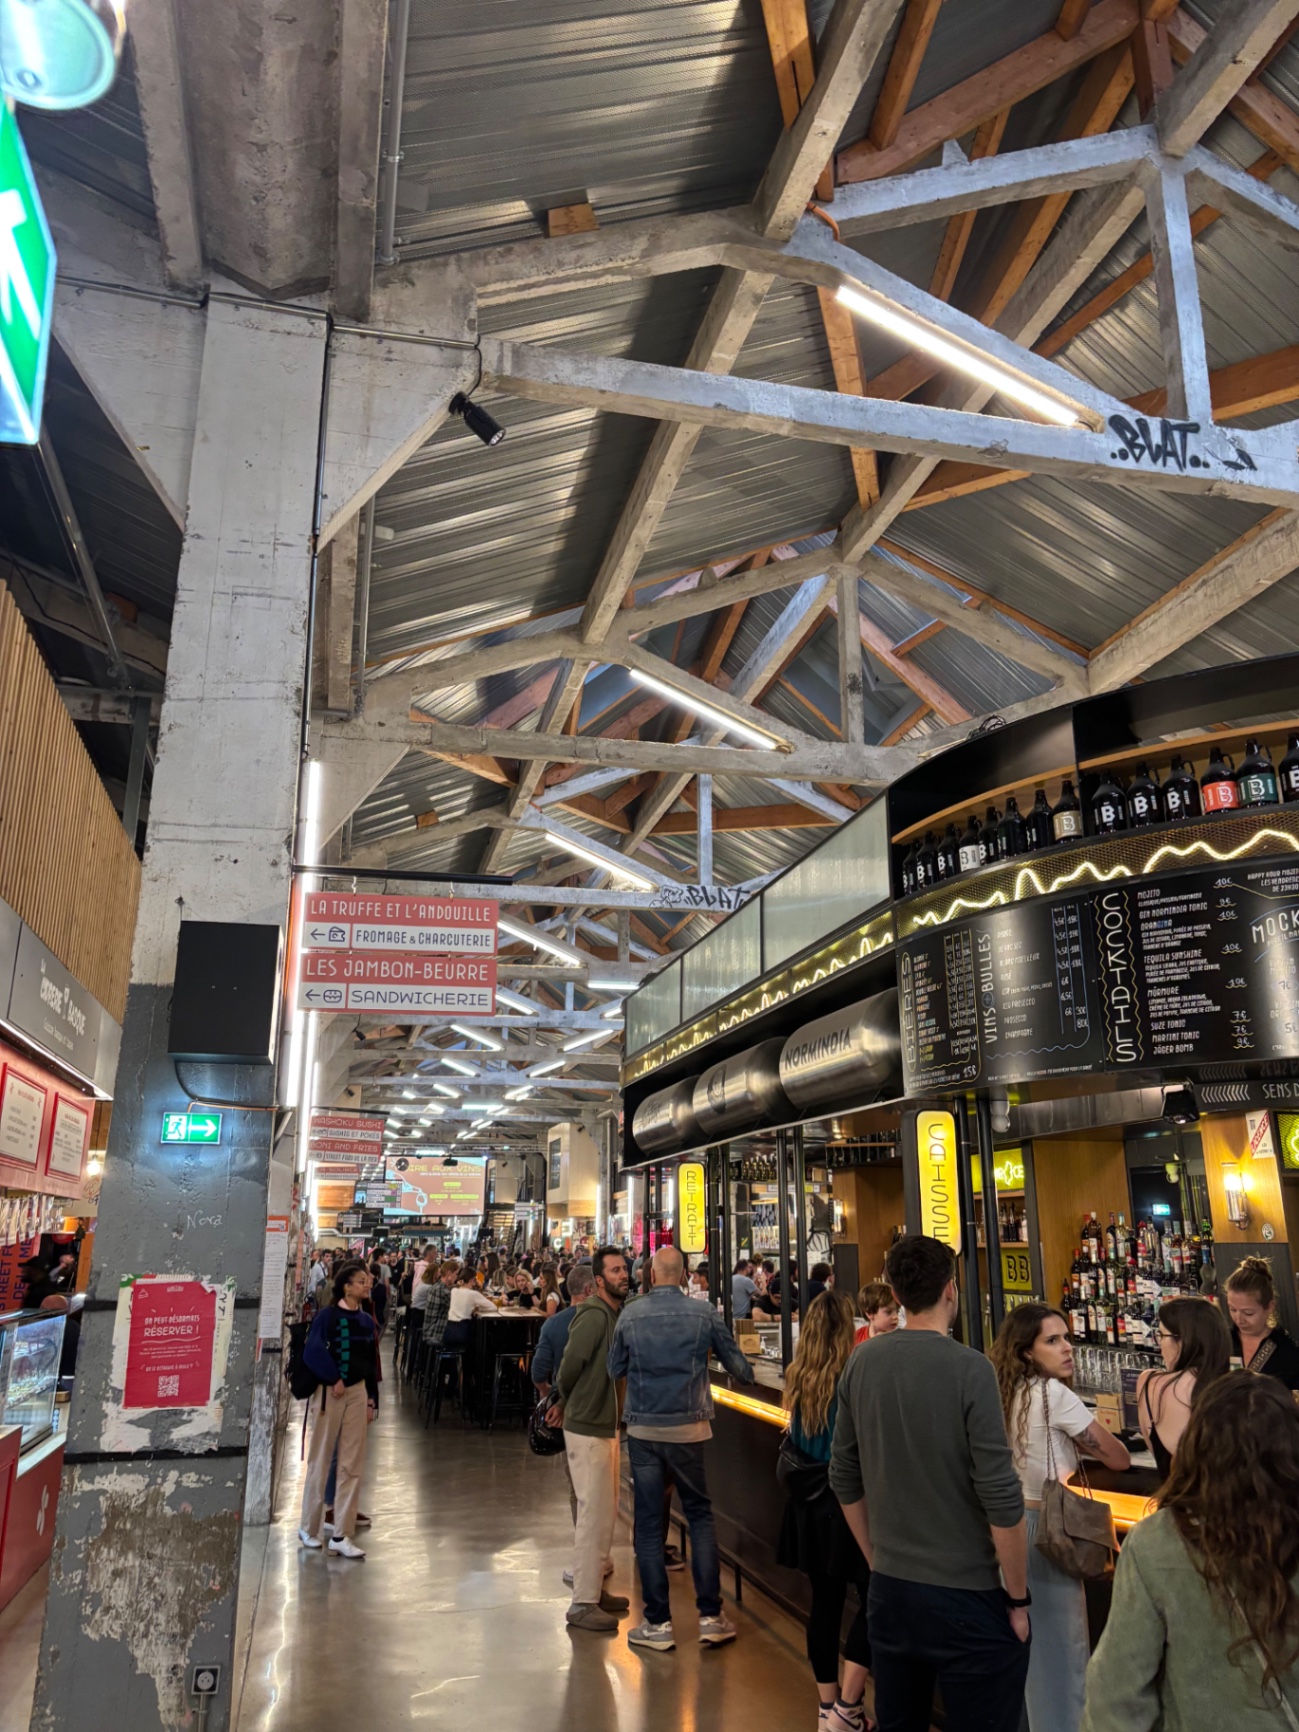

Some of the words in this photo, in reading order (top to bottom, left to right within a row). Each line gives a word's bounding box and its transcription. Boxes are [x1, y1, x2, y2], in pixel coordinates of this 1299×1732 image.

[1133, 796, 1149, 815] B
[1167, 790, 1181, 810] B
[1100, 805, 1115, 823] B
[1137, 889, 1161, 900] MOJITO
[311, 900, 326, 914] LA
[332, 901, 381, 917] TRUFFE
[387, 903, 400, 917] ET
[1139, 911, 1150, 919] GIN
[1152, 904, 1187, 917] NORMINDIA
[1189, 902, 1208, 912] TONIC
[1141, 919, 1172, 931] ORANGINA
[356, 929, 407, 944] FROMAGE
[418, 932, 491, 947] CHARCUTERIE
[978, 934, 994, 992] BULLES
[1144, 953, 1170, 964] TEQUILA
[1171, 949, 1202, 960] SUNSHINE
[306, 959, 337, 977] LES
[344, 960, 489, 981] JAMBON-BEURRE
[1102, 893, 1137, 1062] COCKTAILS
[351, 990, 489, 1006] SANDWICHERIE
[983, 1008, 998, 1044] VINS
[1151, 1021, 1165, 1031] SUZE
[1167, 1019, 1186, 1029] TONIC
[1152, 1032, 1179, 1043] MARTINI
[1181, 1030, 1200, 1040] TONIC
[784, 1026, 851, 1071] NORMINDIA
[1153, 1044, 1174, 1055] JÄGER
[1175, 1043, 1193, 1053] BOMB
[1262, 1083, 1291, 1099] SENS
[314, 1117, 354, 1126] WASHOKU
[356, 1120, 382, 1129] SUSHI
[353, 1144, 378, 1152] FRIES
[927, 1123, 950, 1247] CAISSE
[686, 1171, 697, 1245] RETRAIT
[145, 1317, 153, 1325] ON
[154, 1315, 168, 1324] PEUT
[169, 1314, 200, 1323] DÉSORMAIS
[144, 1324, 193, 1337] RÉSERVER
